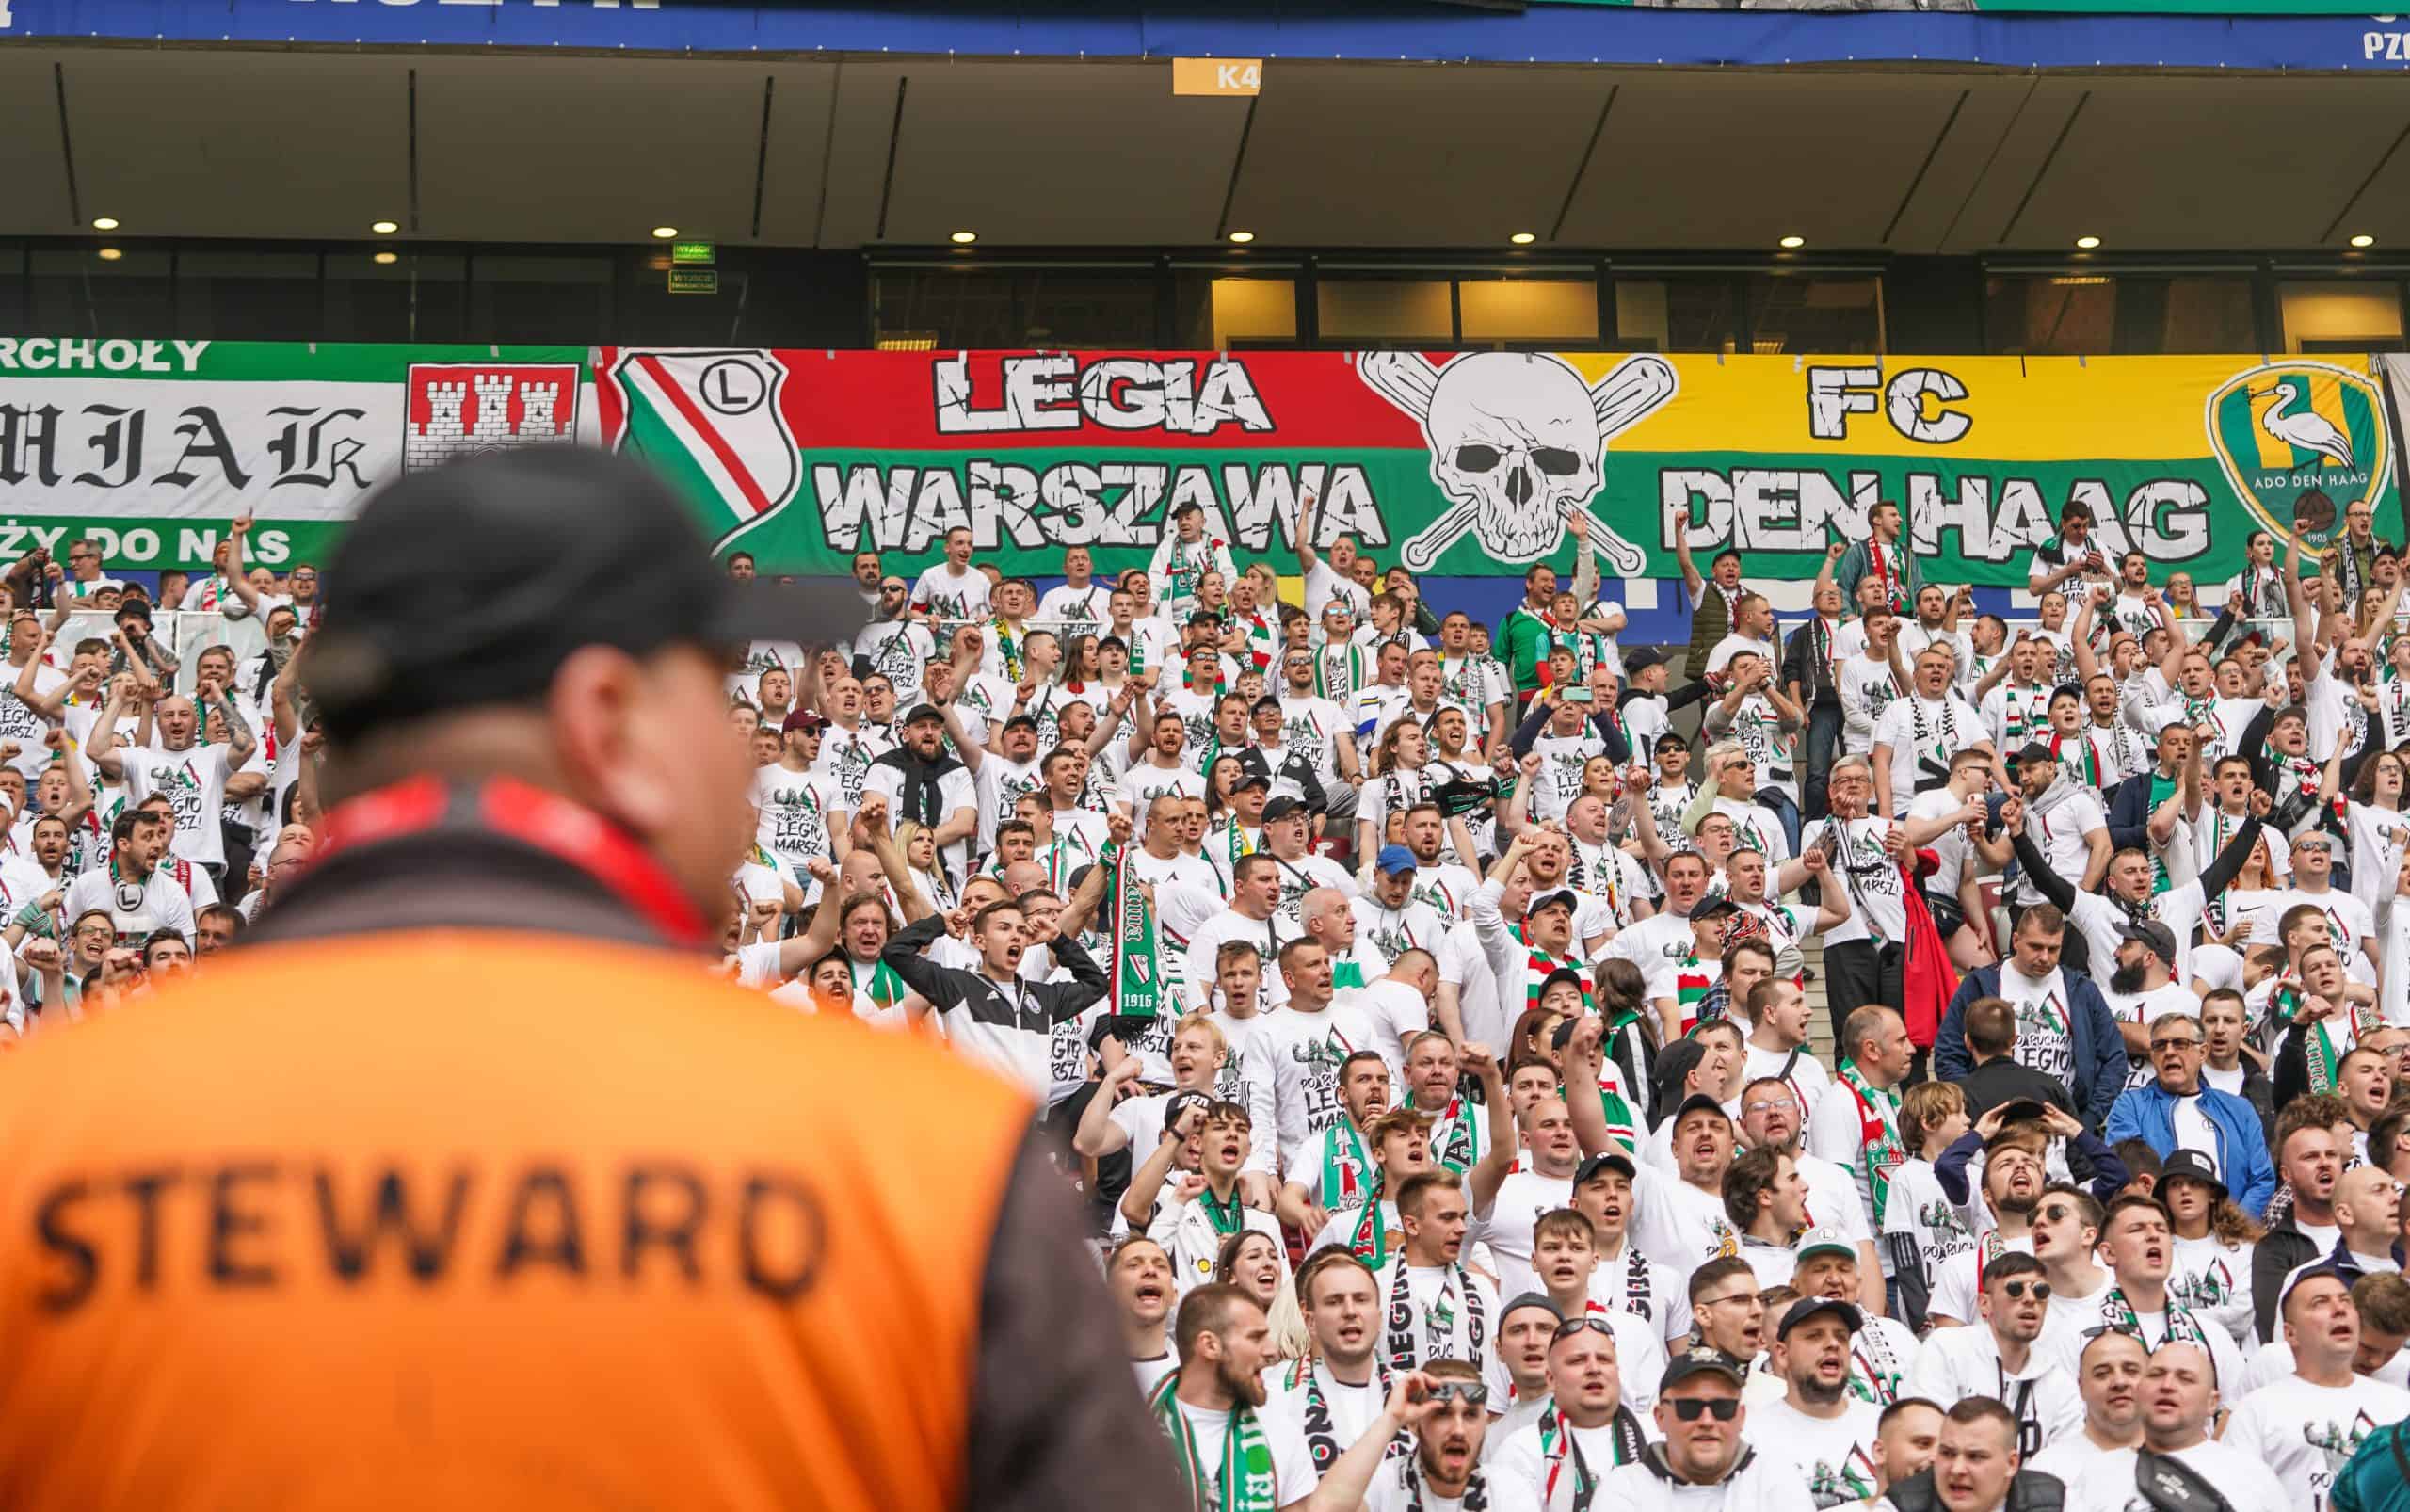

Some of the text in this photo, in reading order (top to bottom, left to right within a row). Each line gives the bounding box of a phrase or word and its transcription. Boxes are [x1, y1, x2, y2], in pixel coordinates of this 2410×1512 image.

[1218, 65, 1260, 89] K4
[936, 358, 1276, 433] LEGIA
[1808, 364, 1972, 443] FC
[2254, 472, 2369, 490] ADO DEN HAAG
[811, 460, 1388, 553] WARSZAWA
[1658, 466, 2211, 564] DEN HAAG
[2307, 533, 2329, 543] 1905
[0, 708, 37, 726] EGIO
[1123, 993, 1152, 1008] 1916
[1052, 1038, 1082, 1061] GIO
[2022, 1047, 2071, 1072] EGIO
[32, 1158, 832, 1316] STEWARD
